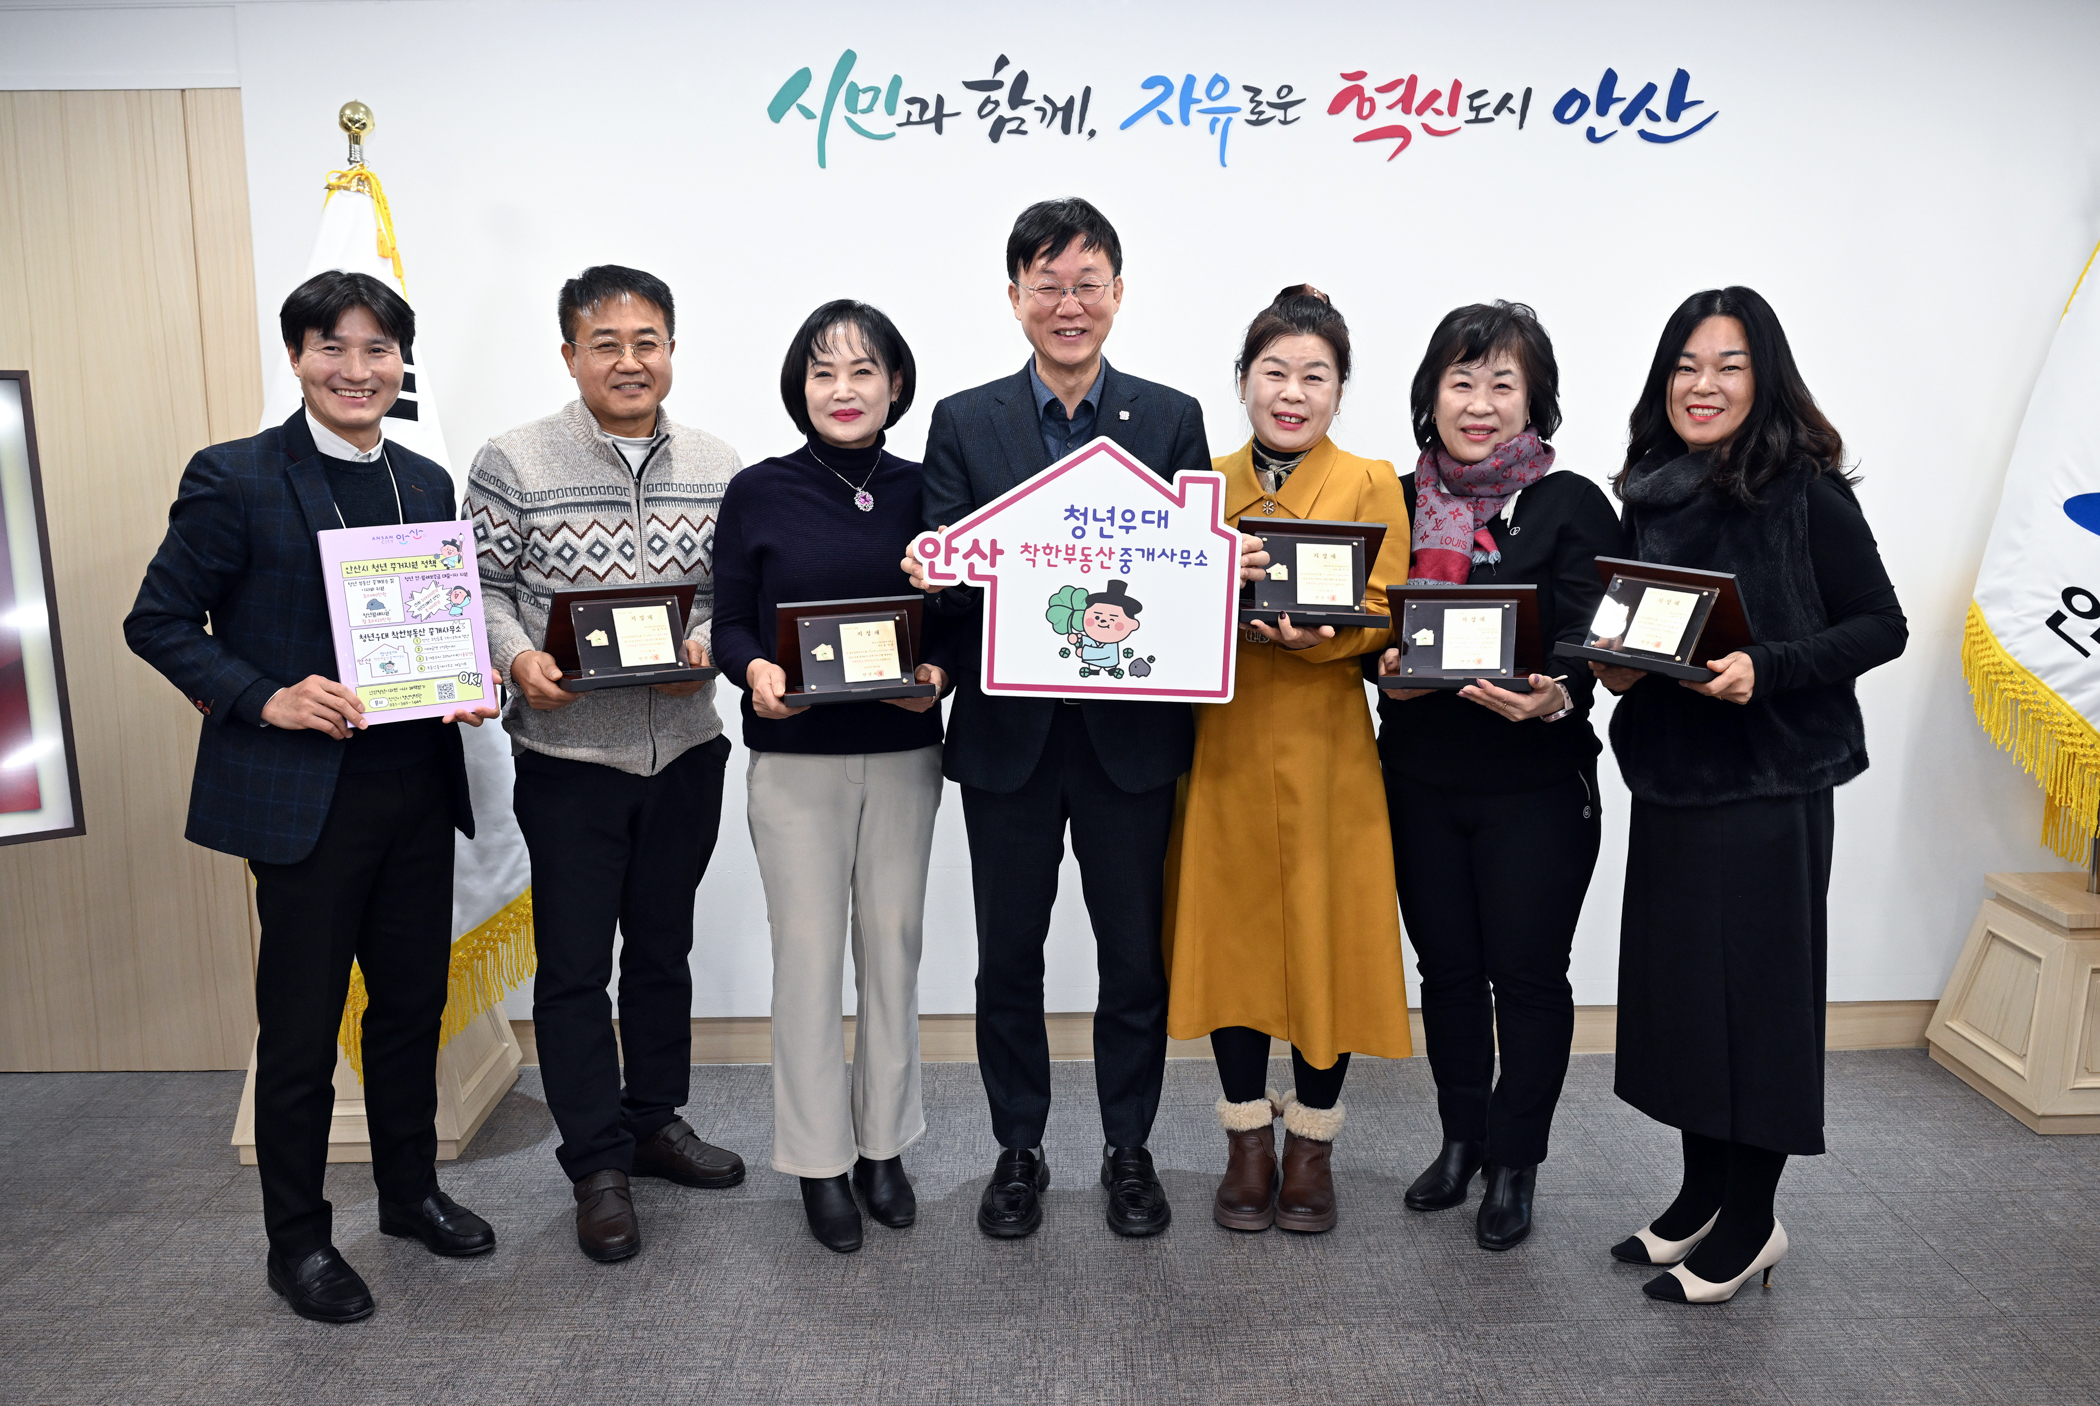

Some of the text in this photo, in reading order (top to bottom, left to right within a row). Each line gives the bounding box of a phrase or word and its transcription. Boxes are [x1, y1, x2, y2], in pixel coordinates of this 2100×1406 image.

[767, 48, 1720, 169] 시민과 함께, 자유로운 혁신도시 안산
[1063, 504, 1169, 539] 청년우대
[1440, 536, 1467, 550] LOUIS
[345, 558, 437, 574] 안산시 청년 주거지원 정책
[918, 537, 1005, 580] 안산
[359, 625, 462, 642] 청년우대 착한부동산 중개사무소
[458, 671, 483, 687] OK!
